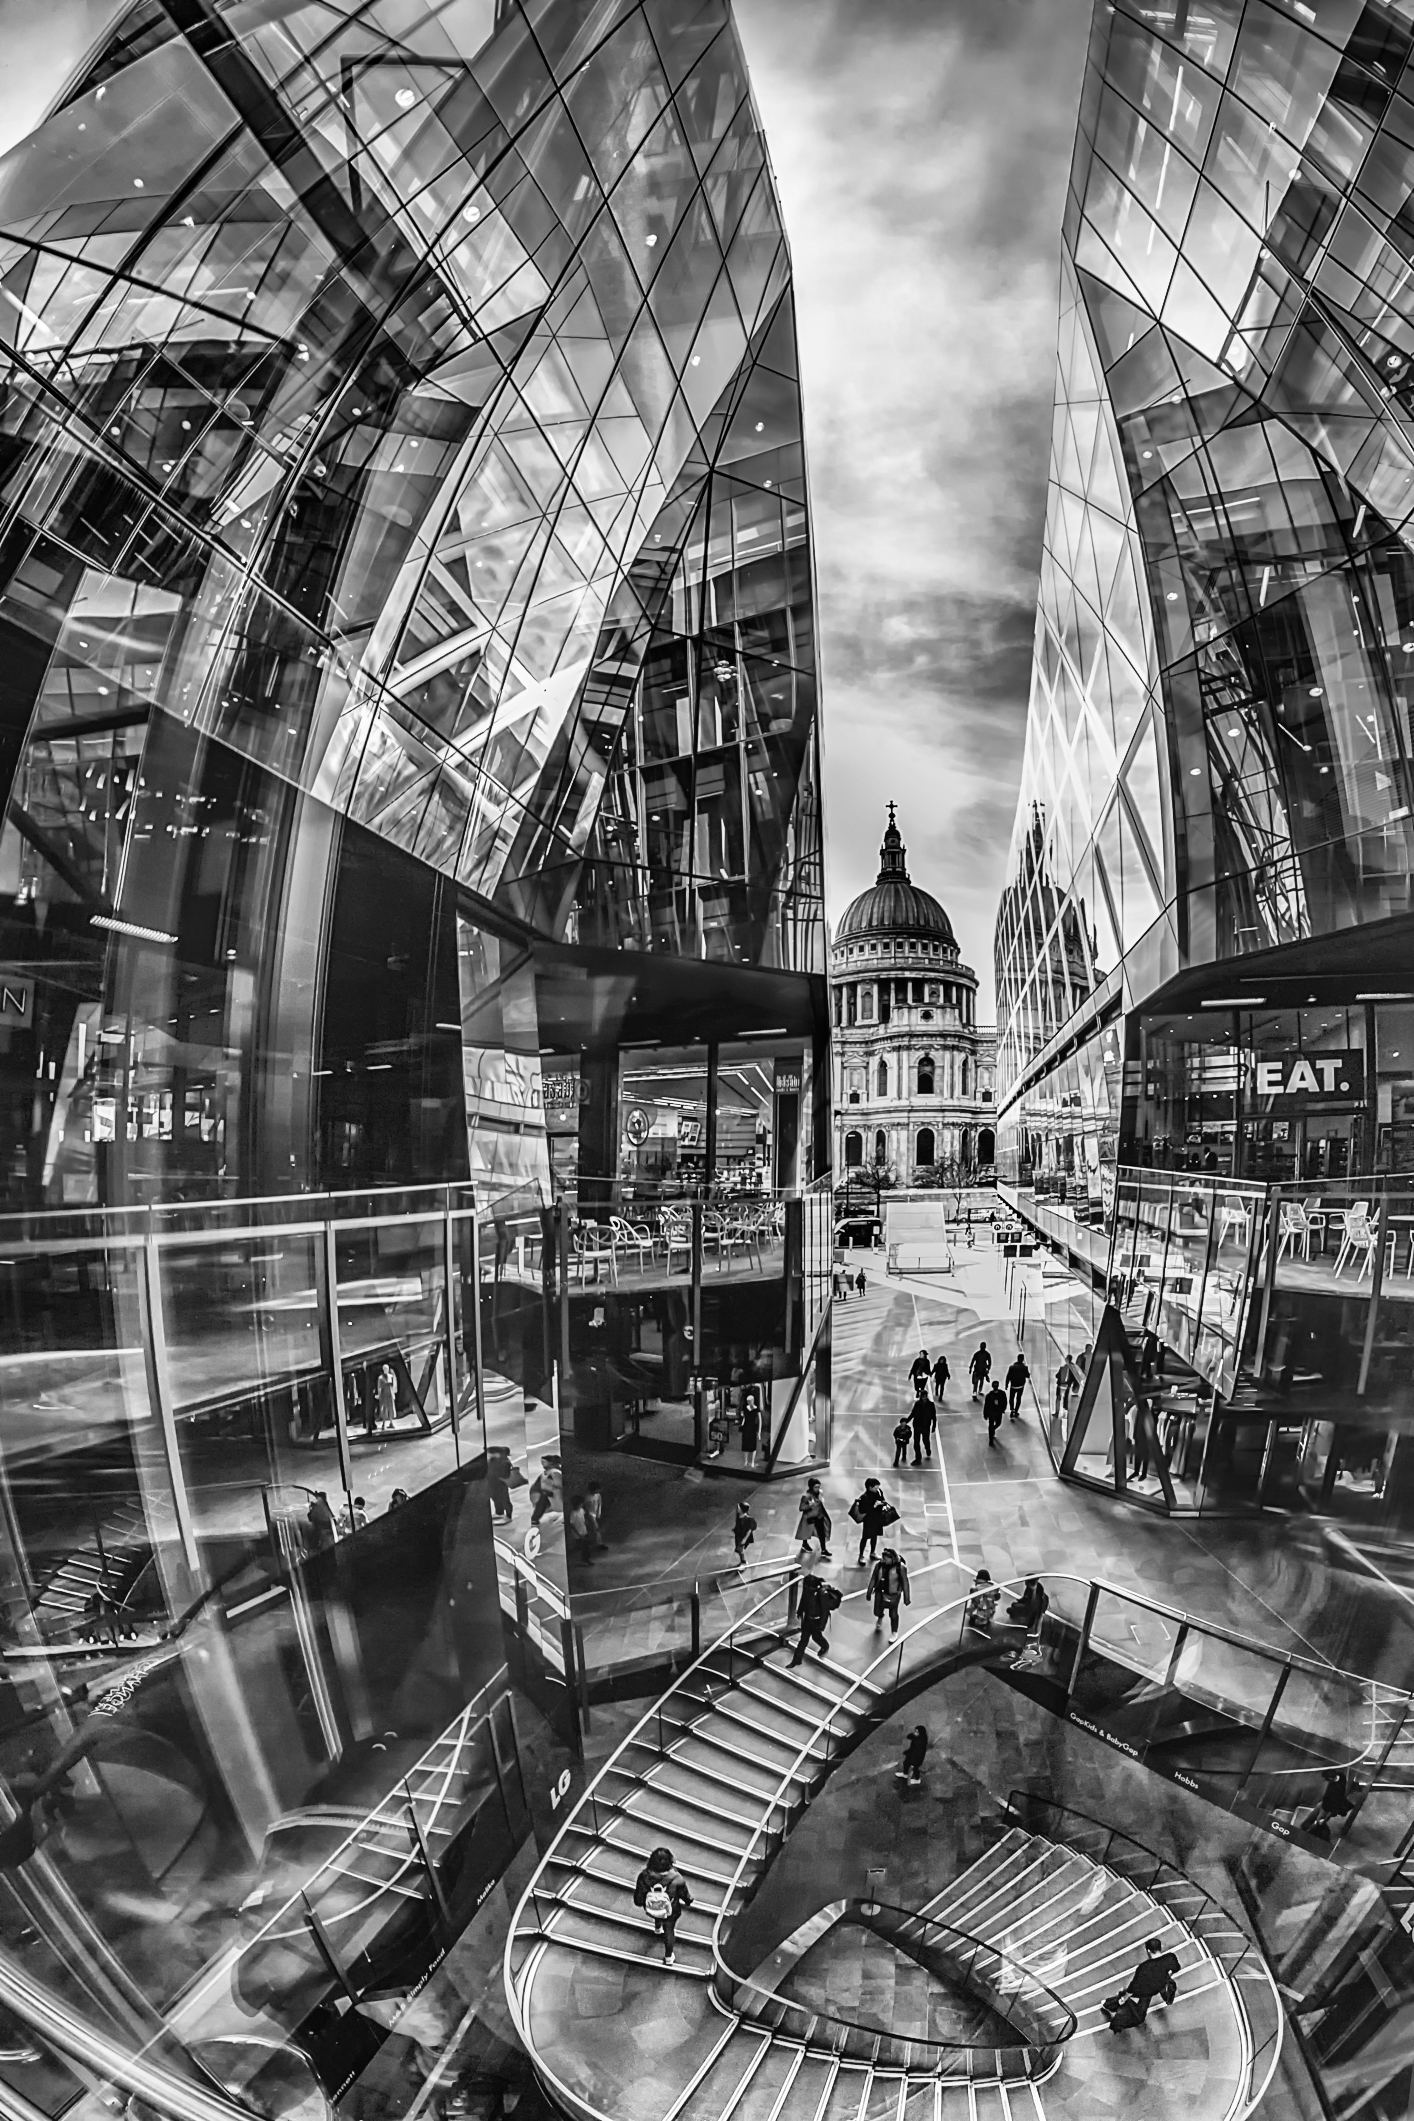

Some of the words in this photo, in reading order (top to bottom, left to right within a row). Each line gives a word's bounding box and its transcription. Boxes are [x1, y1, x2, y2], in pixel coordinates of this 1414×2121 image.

[1257, 1059, 1350, 1094] EAT.
[1070, 1712, 1098, 1733] GapKids
[1099, 1729, 1105, 1737] &
[1106, 1733, 1139, 1757] BabyGap
[550, 1769, 571, 1810] LG
[1174, 1771, 1199, 1789] Hobbs
[1271, 1821, 1290, 1836] Gap
[407, 1972, 428, 2003] Simply
[428, 1947, 446, 1973] Food
